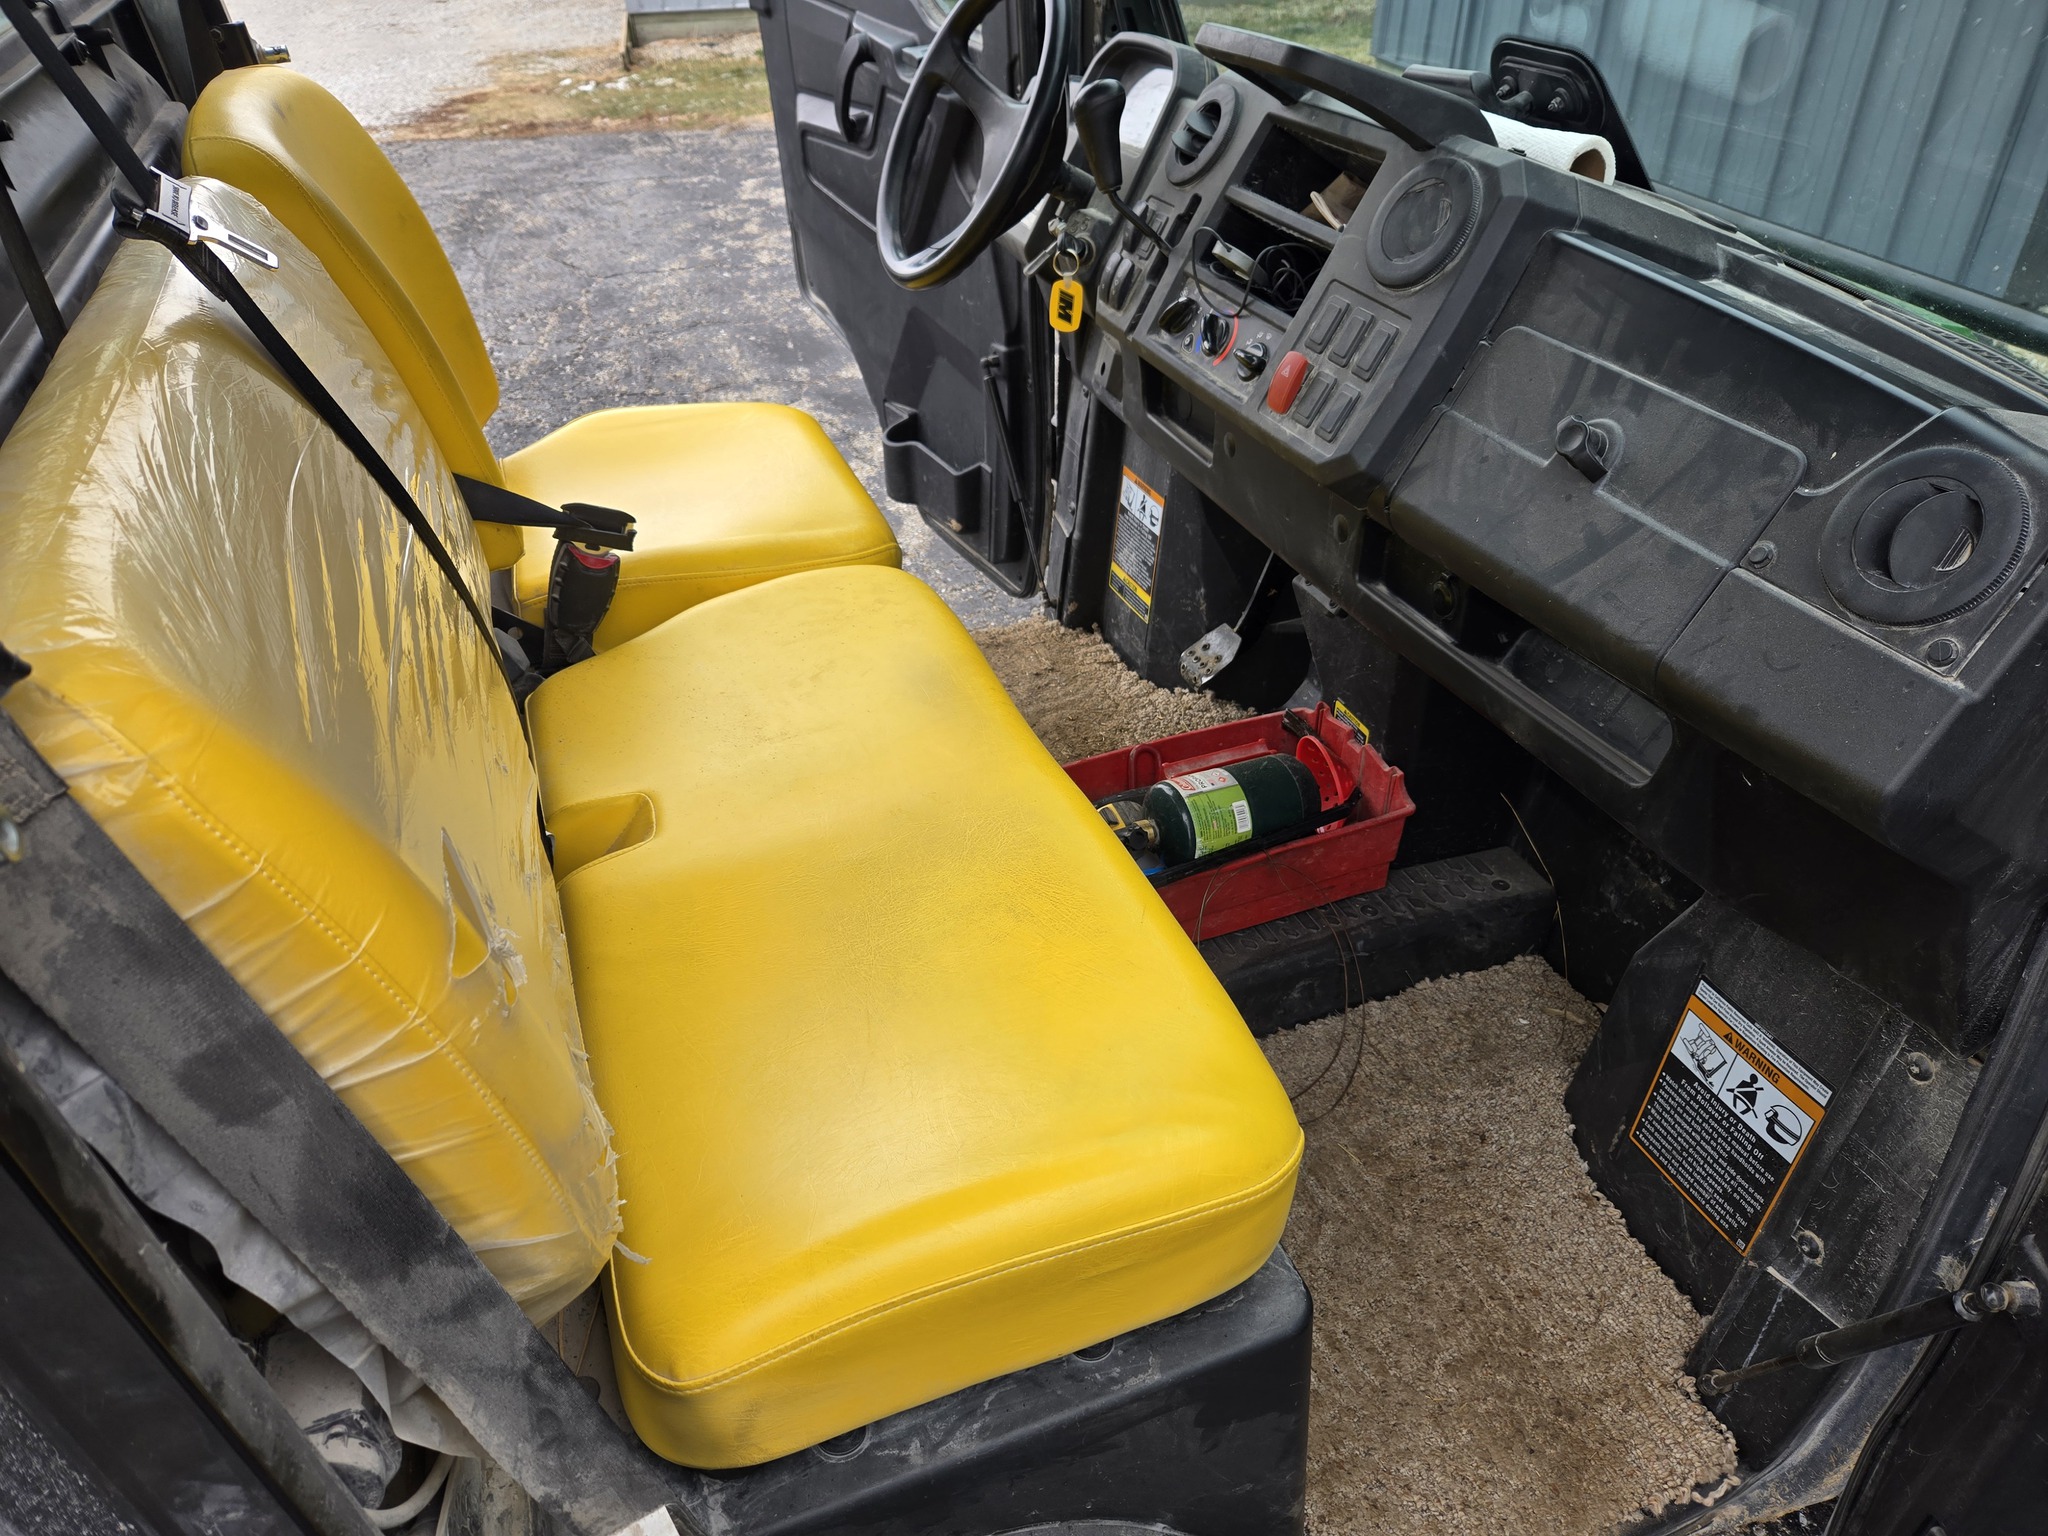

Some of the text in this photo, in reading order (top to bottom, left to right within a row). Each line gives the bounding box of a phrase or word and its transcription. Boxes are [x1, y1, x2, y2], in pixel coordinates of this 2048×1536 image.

[1733, 1038, 1780, 1084] WARNING
[1661, 1080, 1766, 1185] Passengers must be able to grasp handholds with
[1665, 1074, 1678, 1090] Watch
[1677, 1086, 1690, 1101] video
[1689, 1098, 1699, 1109] and
[1698, 1106, 1709, 1119] read
[1731, 1138, 1749, 1158] manual
[1748, 1155, 1764, 1173] before
[1764, 1170, 1776, 1184] use.
[1680, 1078, 1764, 1161] From Rollover or Falling Off
[1693, 1080, 1756, 1143] Avoid Injury or Death
